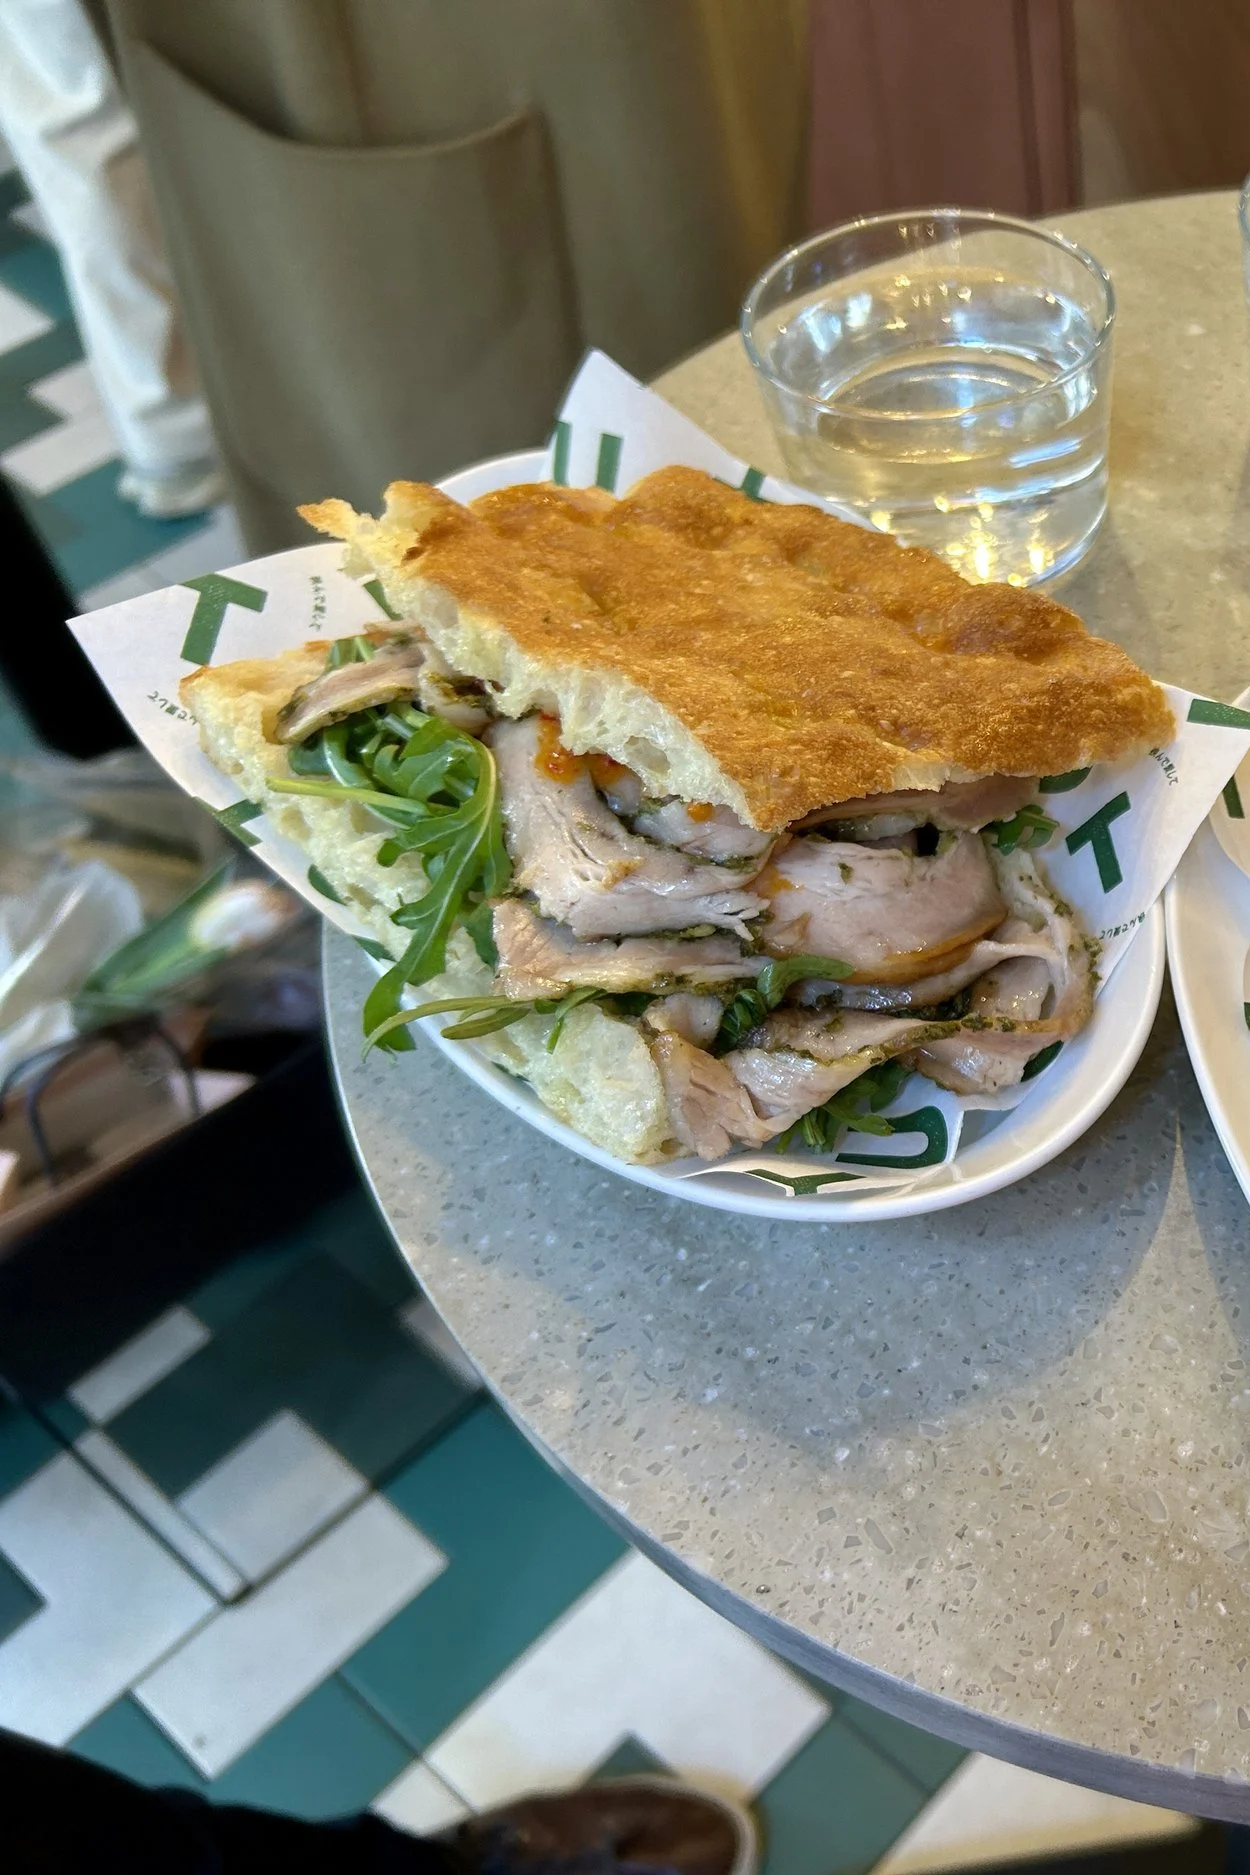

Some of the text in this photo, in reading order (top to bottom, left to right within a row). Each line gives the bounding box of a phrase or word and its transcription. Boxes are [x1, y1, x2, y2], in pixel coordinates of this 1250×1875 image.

[146, 690, 202, 725] んで愛して
[1065, 791, 1131, 894] T
